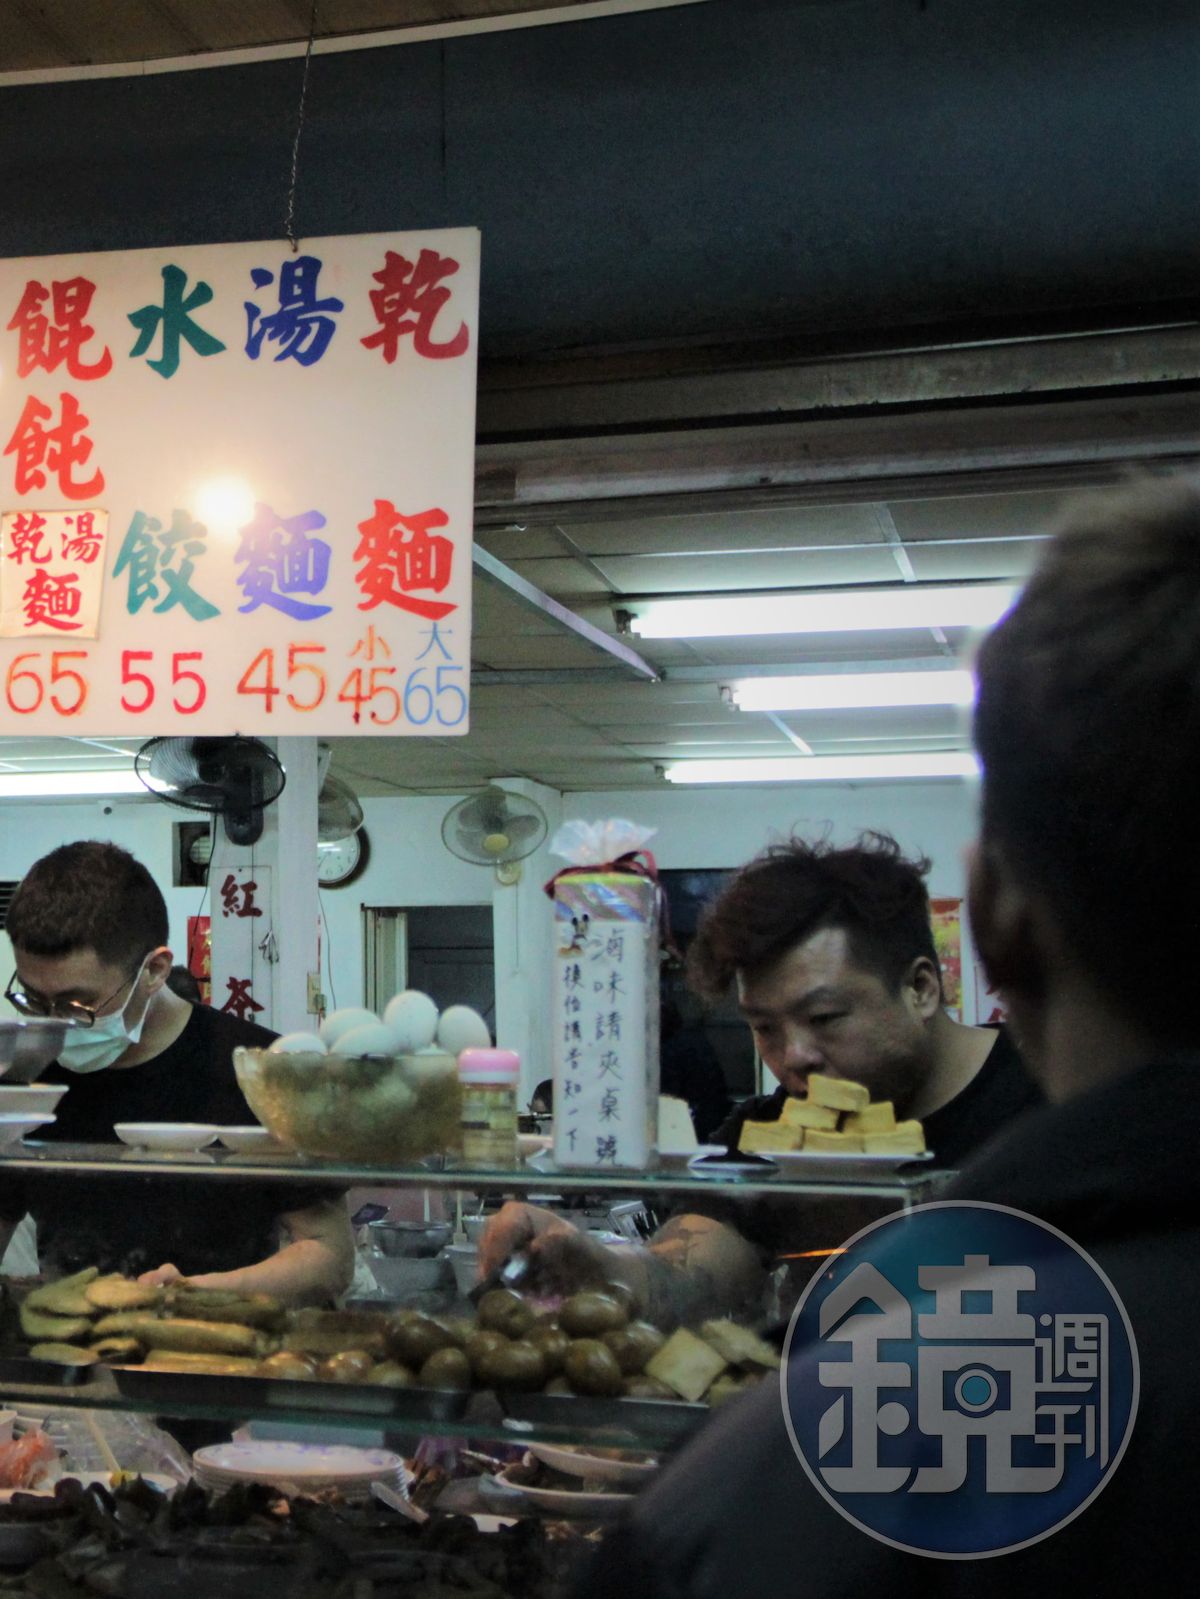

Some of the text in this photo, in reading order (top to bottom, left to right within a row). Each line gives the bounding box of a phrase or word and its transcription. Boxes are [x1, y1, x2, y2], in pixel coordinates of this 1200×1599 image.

[3, 276, 112, 500] 餛飩
[113, 264, 226, 622] 水餃
[234, 255, 344, 621] 湯麵
[353, 248, 469, 621] 乾麵
[349, 625, 392, 662] 小
[405, 622, 454, 661] 大
[5, 651, 89, 716] 65
[119, 651, 207, 715] 55
[236, 643, 327, 714] 45
[338, 668, 401, 726] 45
[404, 666, 468, 727] 65
[220, 874, 265, 1020] 紅茶
